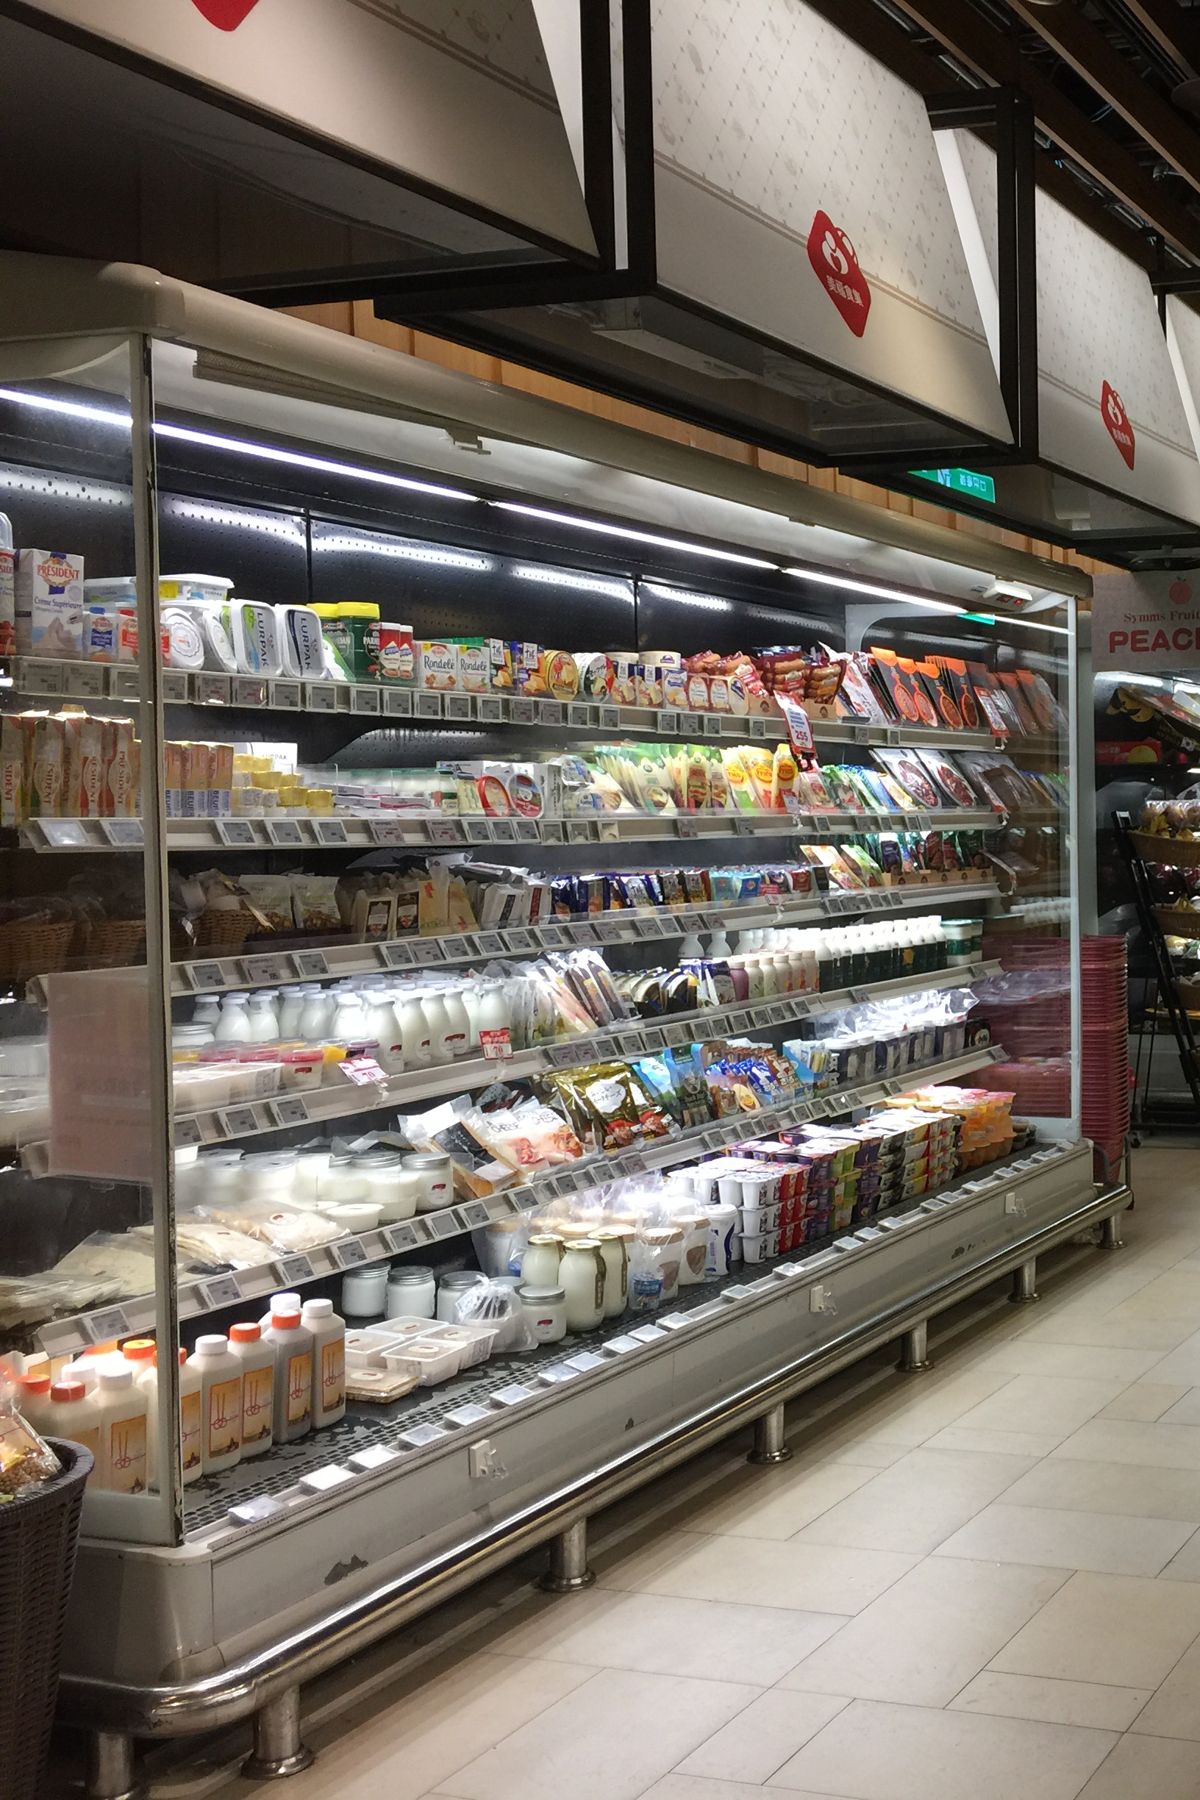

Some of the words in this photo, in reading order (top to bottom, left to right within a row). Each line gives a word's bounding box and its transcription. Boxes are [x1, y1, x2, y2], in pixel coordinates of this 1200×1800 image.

[37, 563, 80, 579] PRÉSIDENT
[1123, 611, 1166, 624] Symms
[1170, 610, 1200, 621] Fruit
[257, 612, 269, 667] LURPAK
[301, 617, 312, 670] LURPAK
